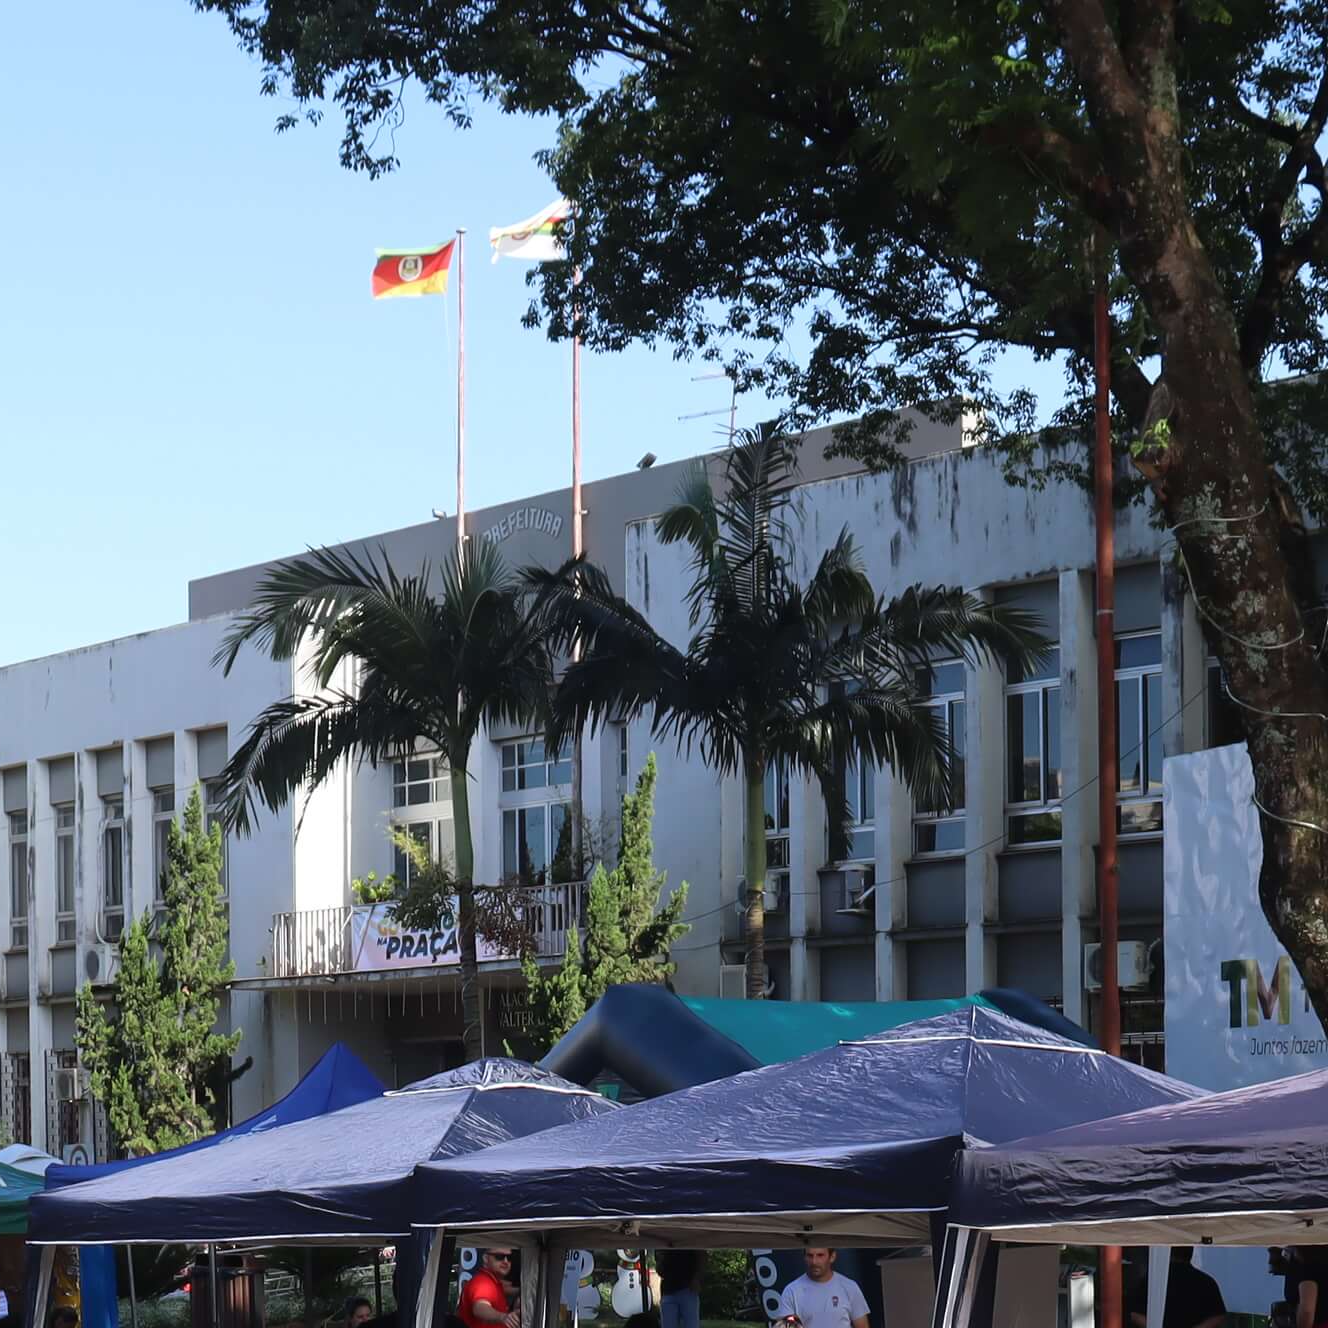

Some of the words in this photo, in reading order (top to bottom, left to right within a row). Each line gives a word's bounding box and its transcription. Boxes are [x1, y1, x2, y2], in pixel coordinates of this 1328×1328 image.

[483, 507, 562, 545] PREFEITURA
[386, 930, 458, 963] PRAÇA
[1250, 1038, 1288, 1055] Juntos
